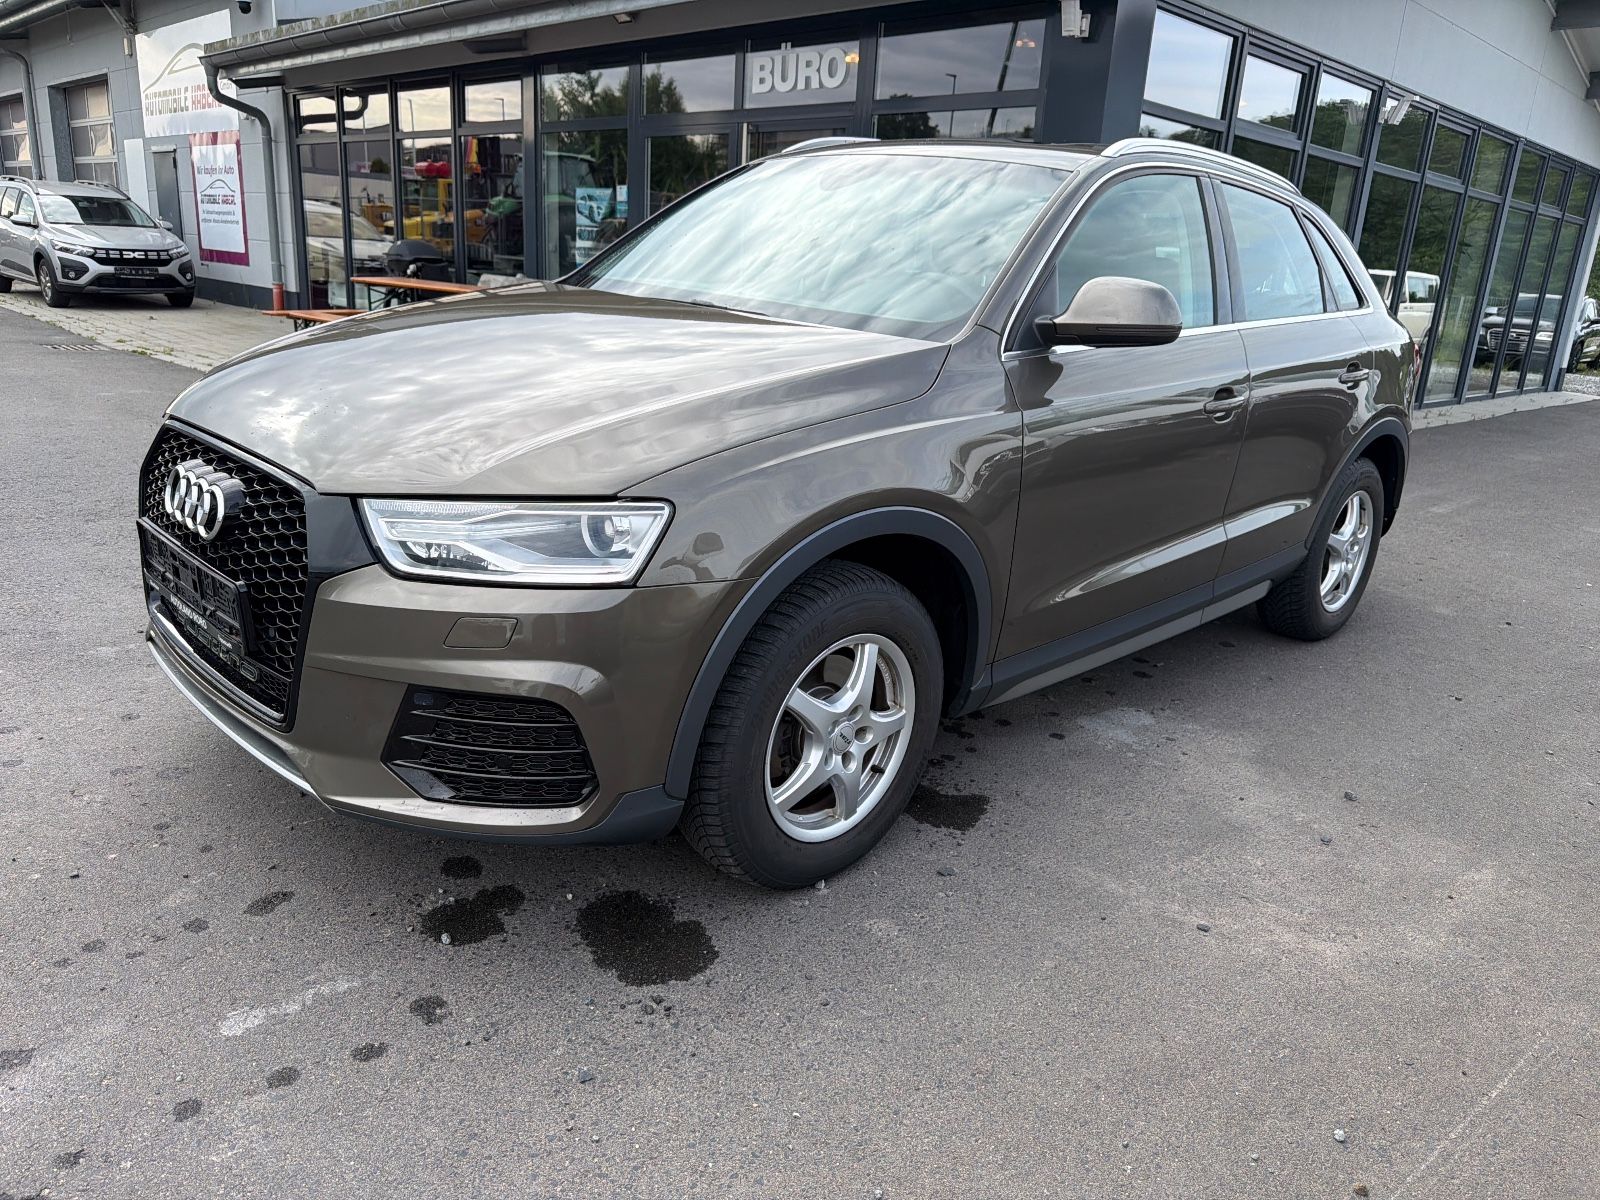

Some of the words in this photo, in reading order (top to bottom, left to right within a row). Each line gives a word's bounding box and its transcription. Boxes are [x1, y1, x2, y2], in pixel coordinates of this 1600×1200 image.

[752, 42, 847, 94] BÜRO
[145, 86, 189, 116] AUTOMOBILE
[203, 165, 217, 177] kaufen
[223, 164, 235, 175] Auto
